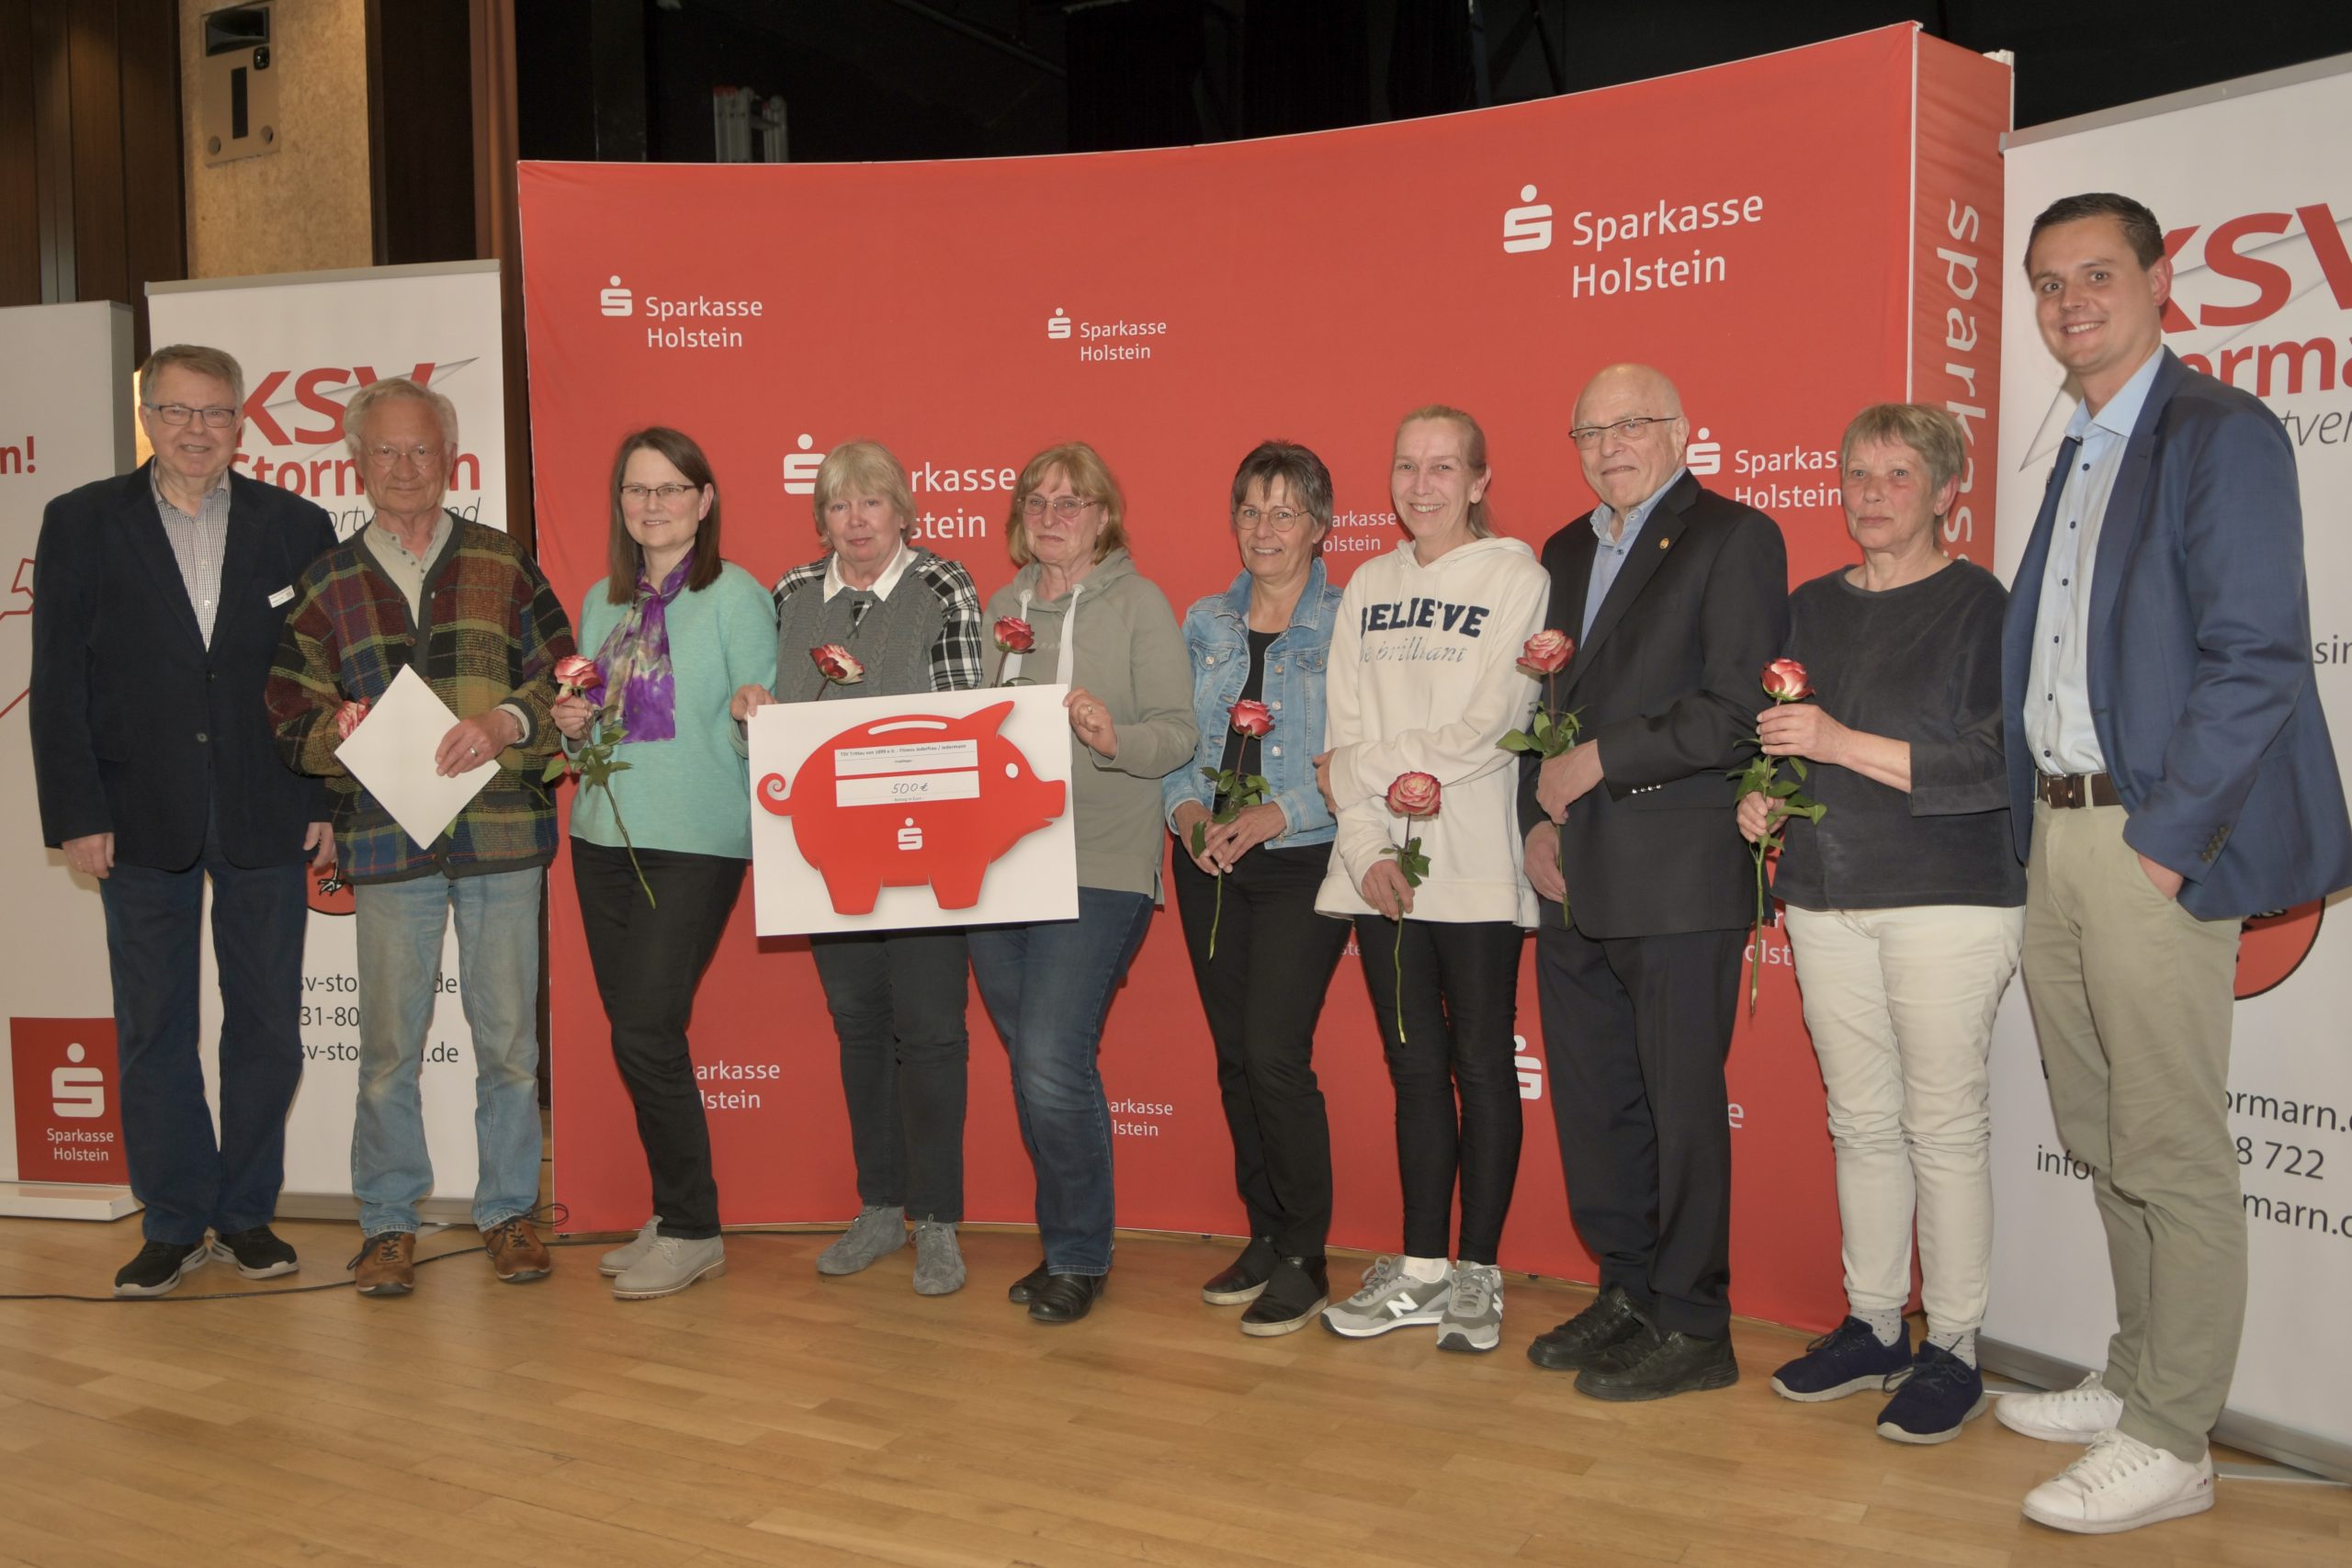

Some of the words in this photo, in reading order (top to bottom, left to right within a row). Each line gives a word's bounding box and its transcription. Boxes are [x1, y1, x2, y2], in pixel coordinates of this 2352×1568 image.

[1572, 193, 1764, 251] Sparkasse
[1572, 250, 1726, 299] Holstein
[645, 296, 763, 321] Sparkasse
[647, 326, 743, 348] Holstein
[1080, 320, 1167, 341] Sparkasse
[1080, 343, 1151, 362] Holstein
[1734, 446, 1838, 479] Sparkas
[911, 462, 1016, 492] rkasse
[1735, 482, 1842, 509] Holstein
[910, 508, 986, 539] stein
[1332, 510, 1396, 527] arkasse
[1323, 535, 1381, 552] olstein
[695, 1059, 781, 1080] arkasse
[699, 1089, 761, 1110] lstein
[1108, 1098, 1173, 1115] arkasse
[46, 1128, 115, 1146] Sparkasse
[1113, 1119, 1159, 1137] lstein
[52, 1146, 109, 1162] Holstein
[2265, 1141, 2324, 1180] 722
